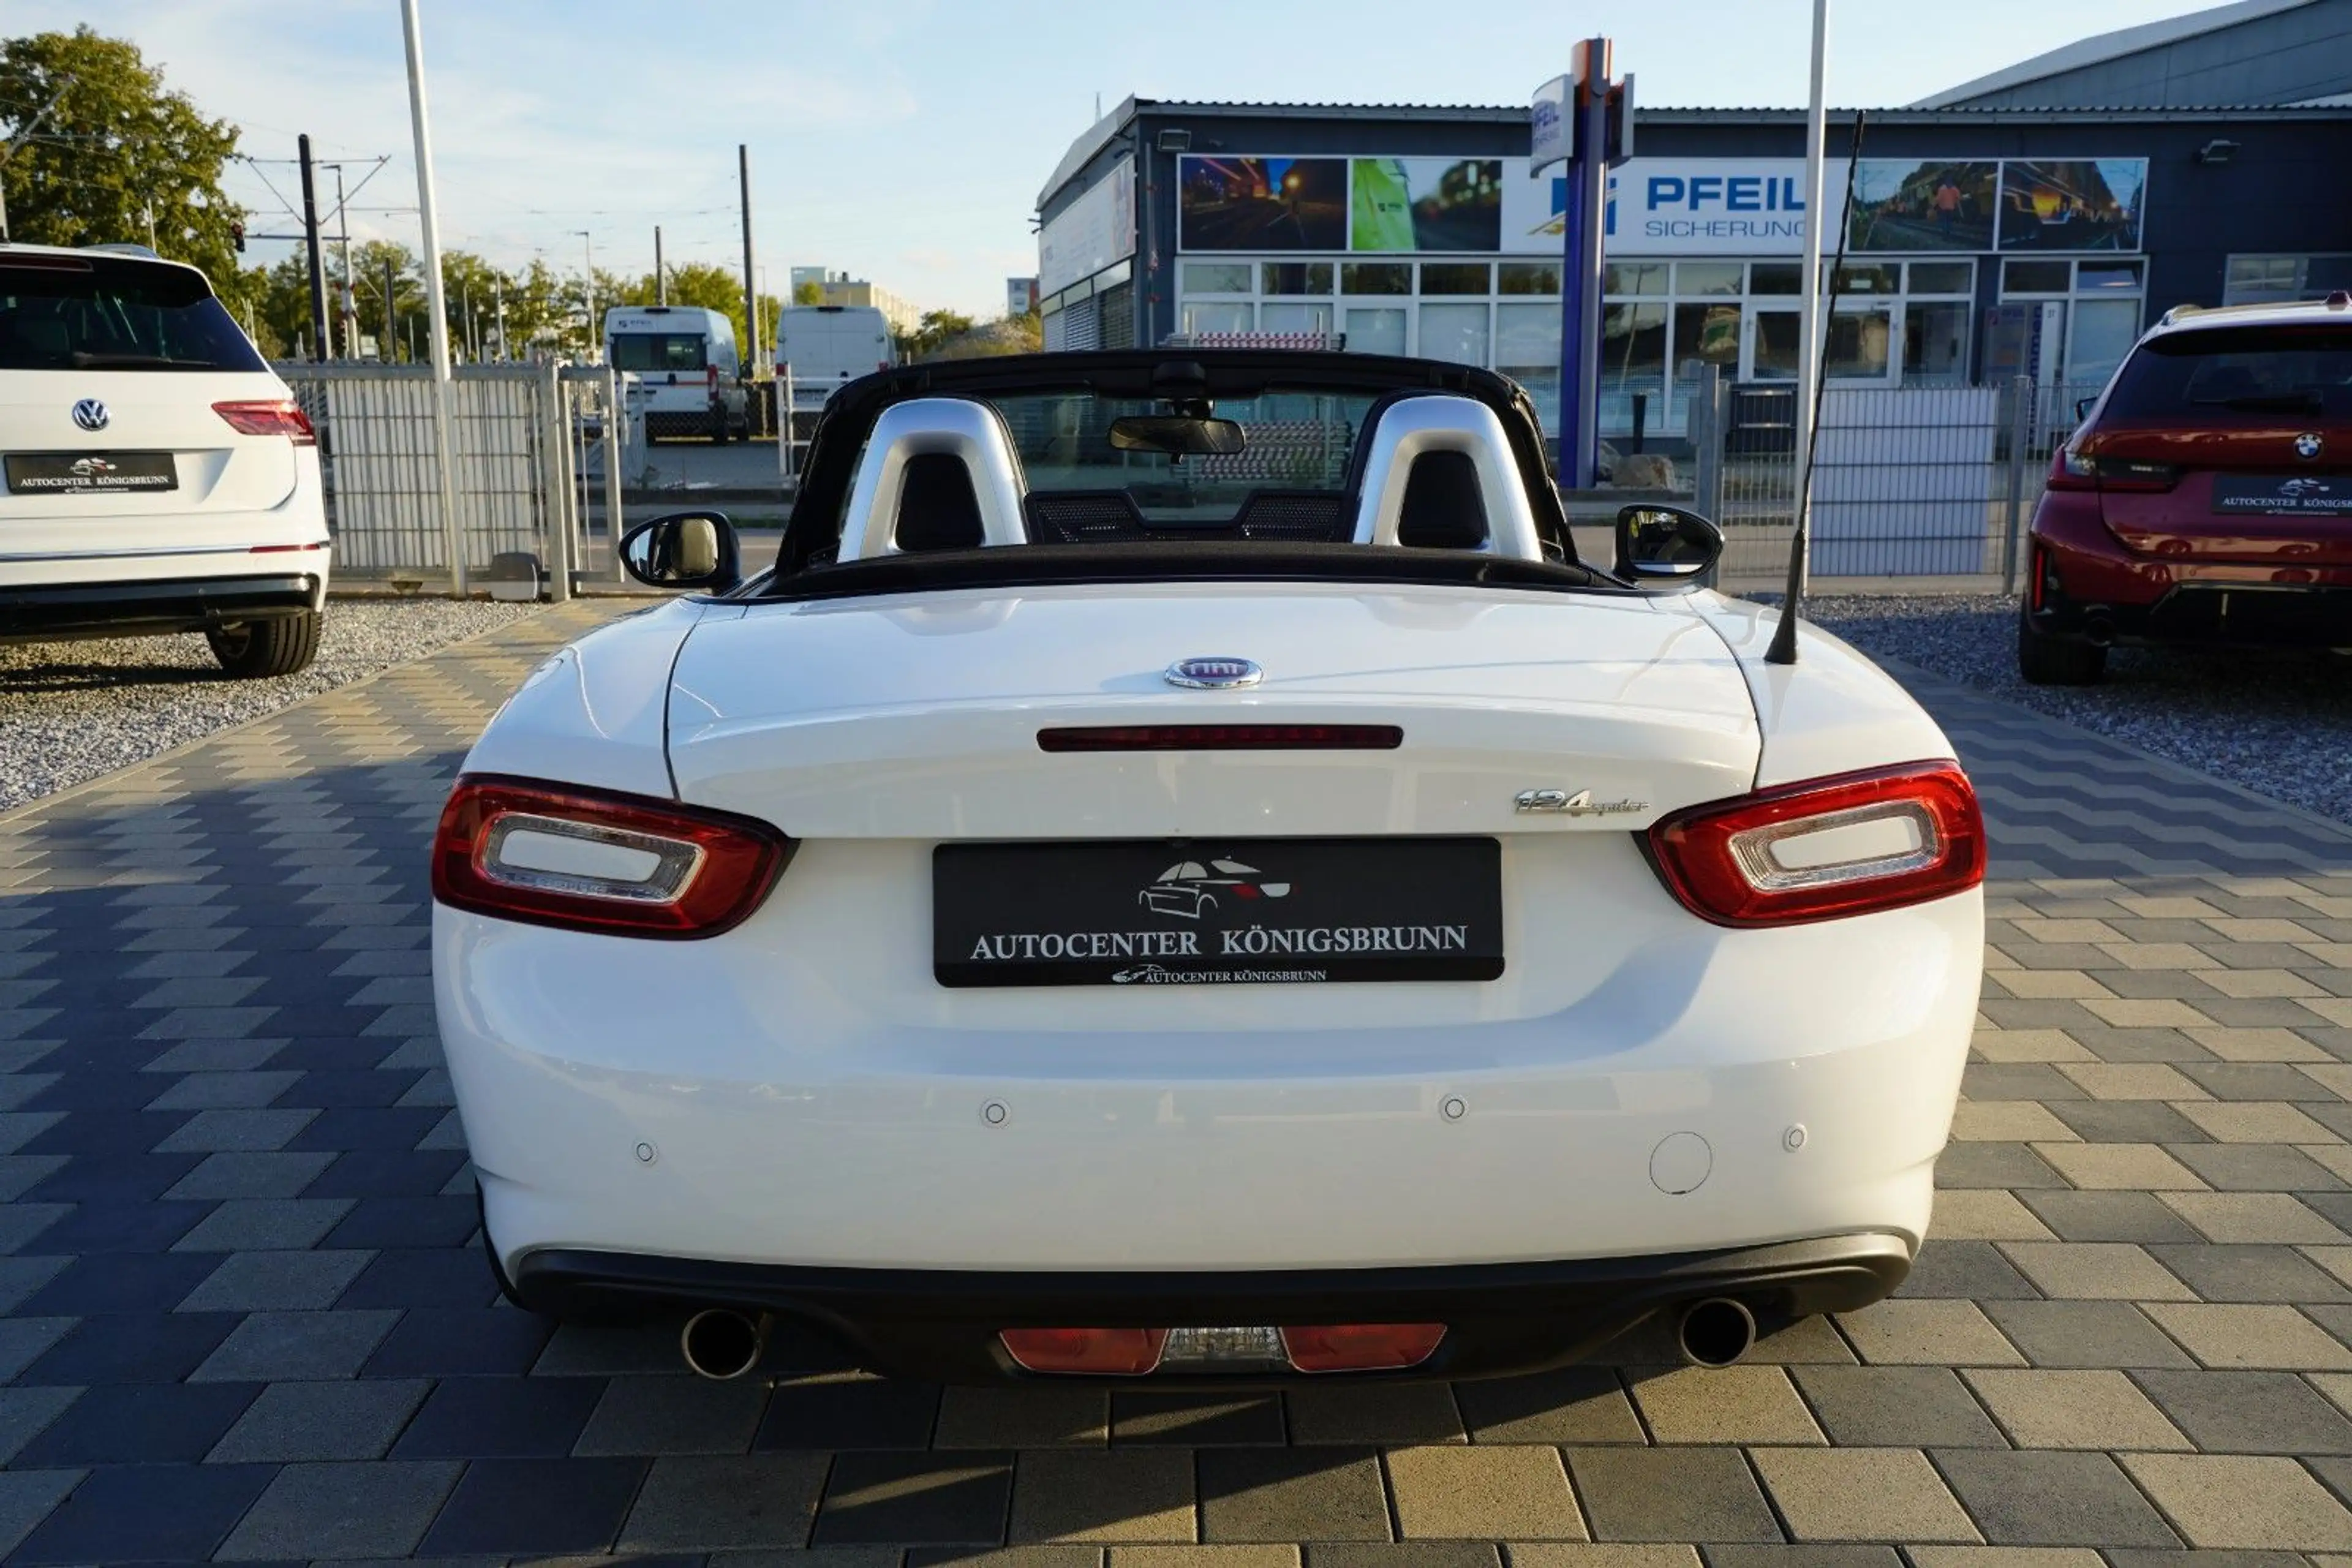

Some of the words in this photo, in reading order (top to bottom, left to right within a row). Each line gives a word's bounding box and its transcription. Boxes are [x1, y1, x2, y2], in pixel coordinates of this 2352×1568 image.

[1647, 177, 1805, 211] PFEIL
[21, 477, 91, 486] AUTOCENTER
[97, 475, 168, 484] KÖNIGSBRUNN
[2222, 497, 2296, 507] AUTOCENTER
[970, 931, 1202, 959] AUTOCENTER
[1220, 924, 1468, 954] KÖNIGSBRUNN
[1145, 971, 1231, 983] AUTOCENTER
[1234, 969, 1327, 982] KÖNIGSBRUNN
